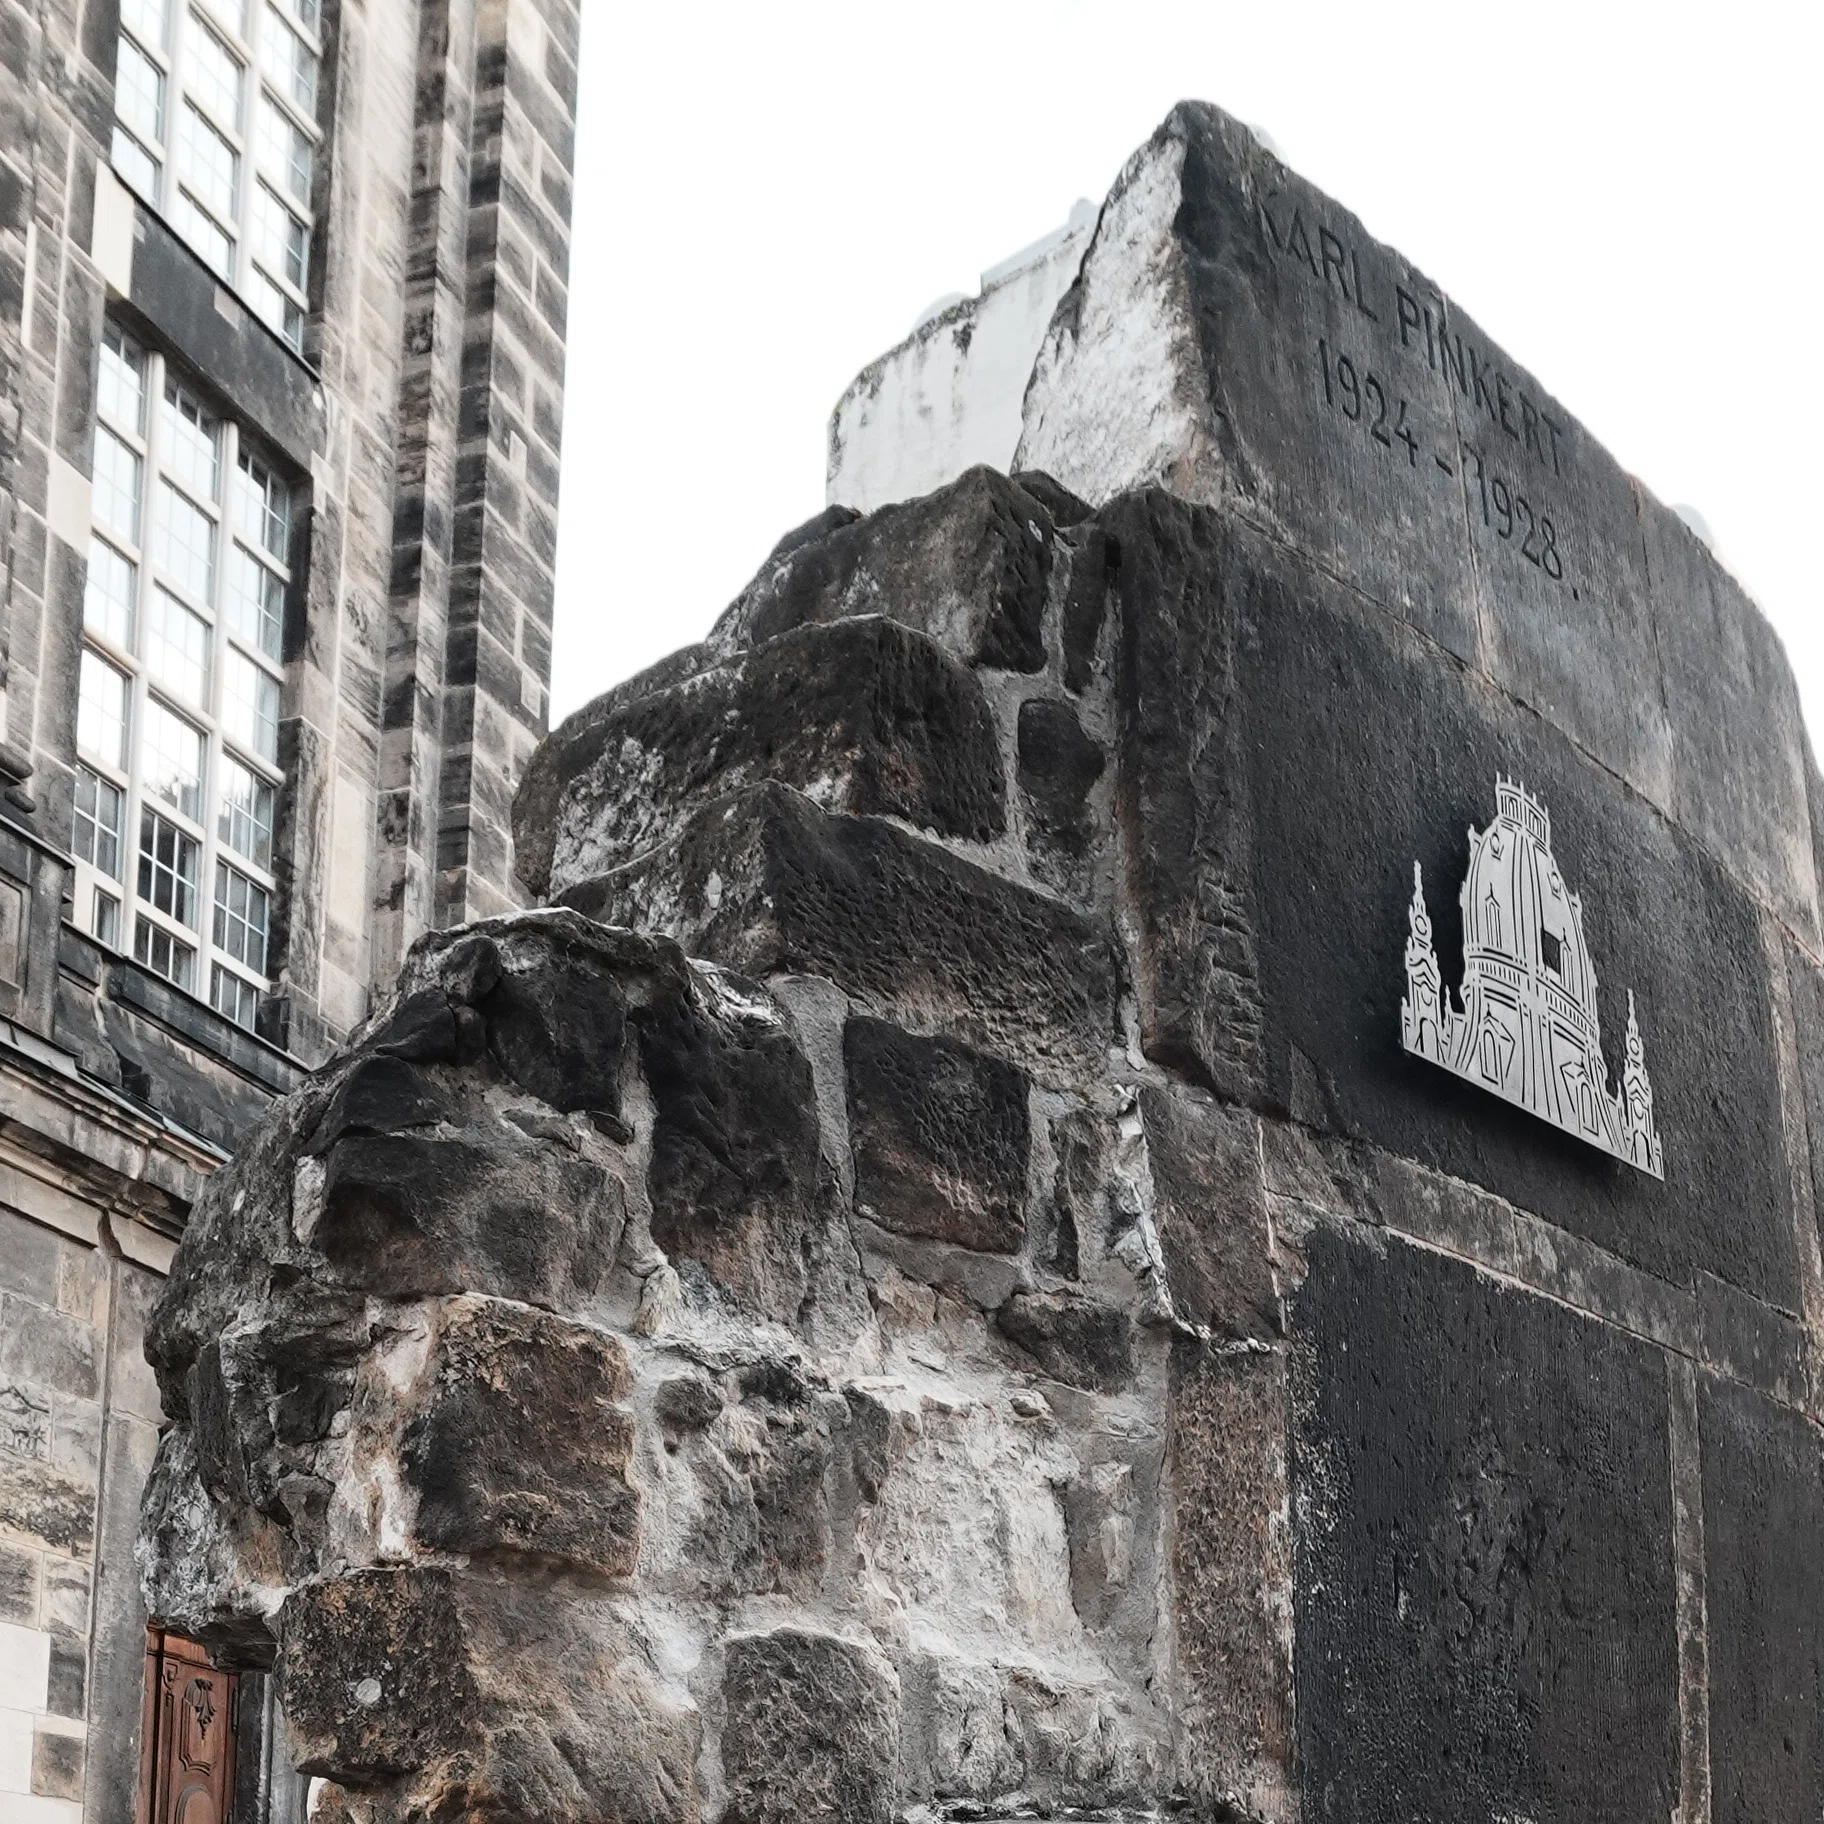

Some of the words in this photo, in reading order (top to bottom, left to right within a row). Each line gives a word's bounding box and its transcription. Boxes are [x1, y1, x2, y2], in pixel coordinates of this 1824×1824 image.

[1318, 337, 1419, 469] 1924
[1463, 441, 1563, 581] 1928
[1395, 284, 1564, 479] PINKERT
